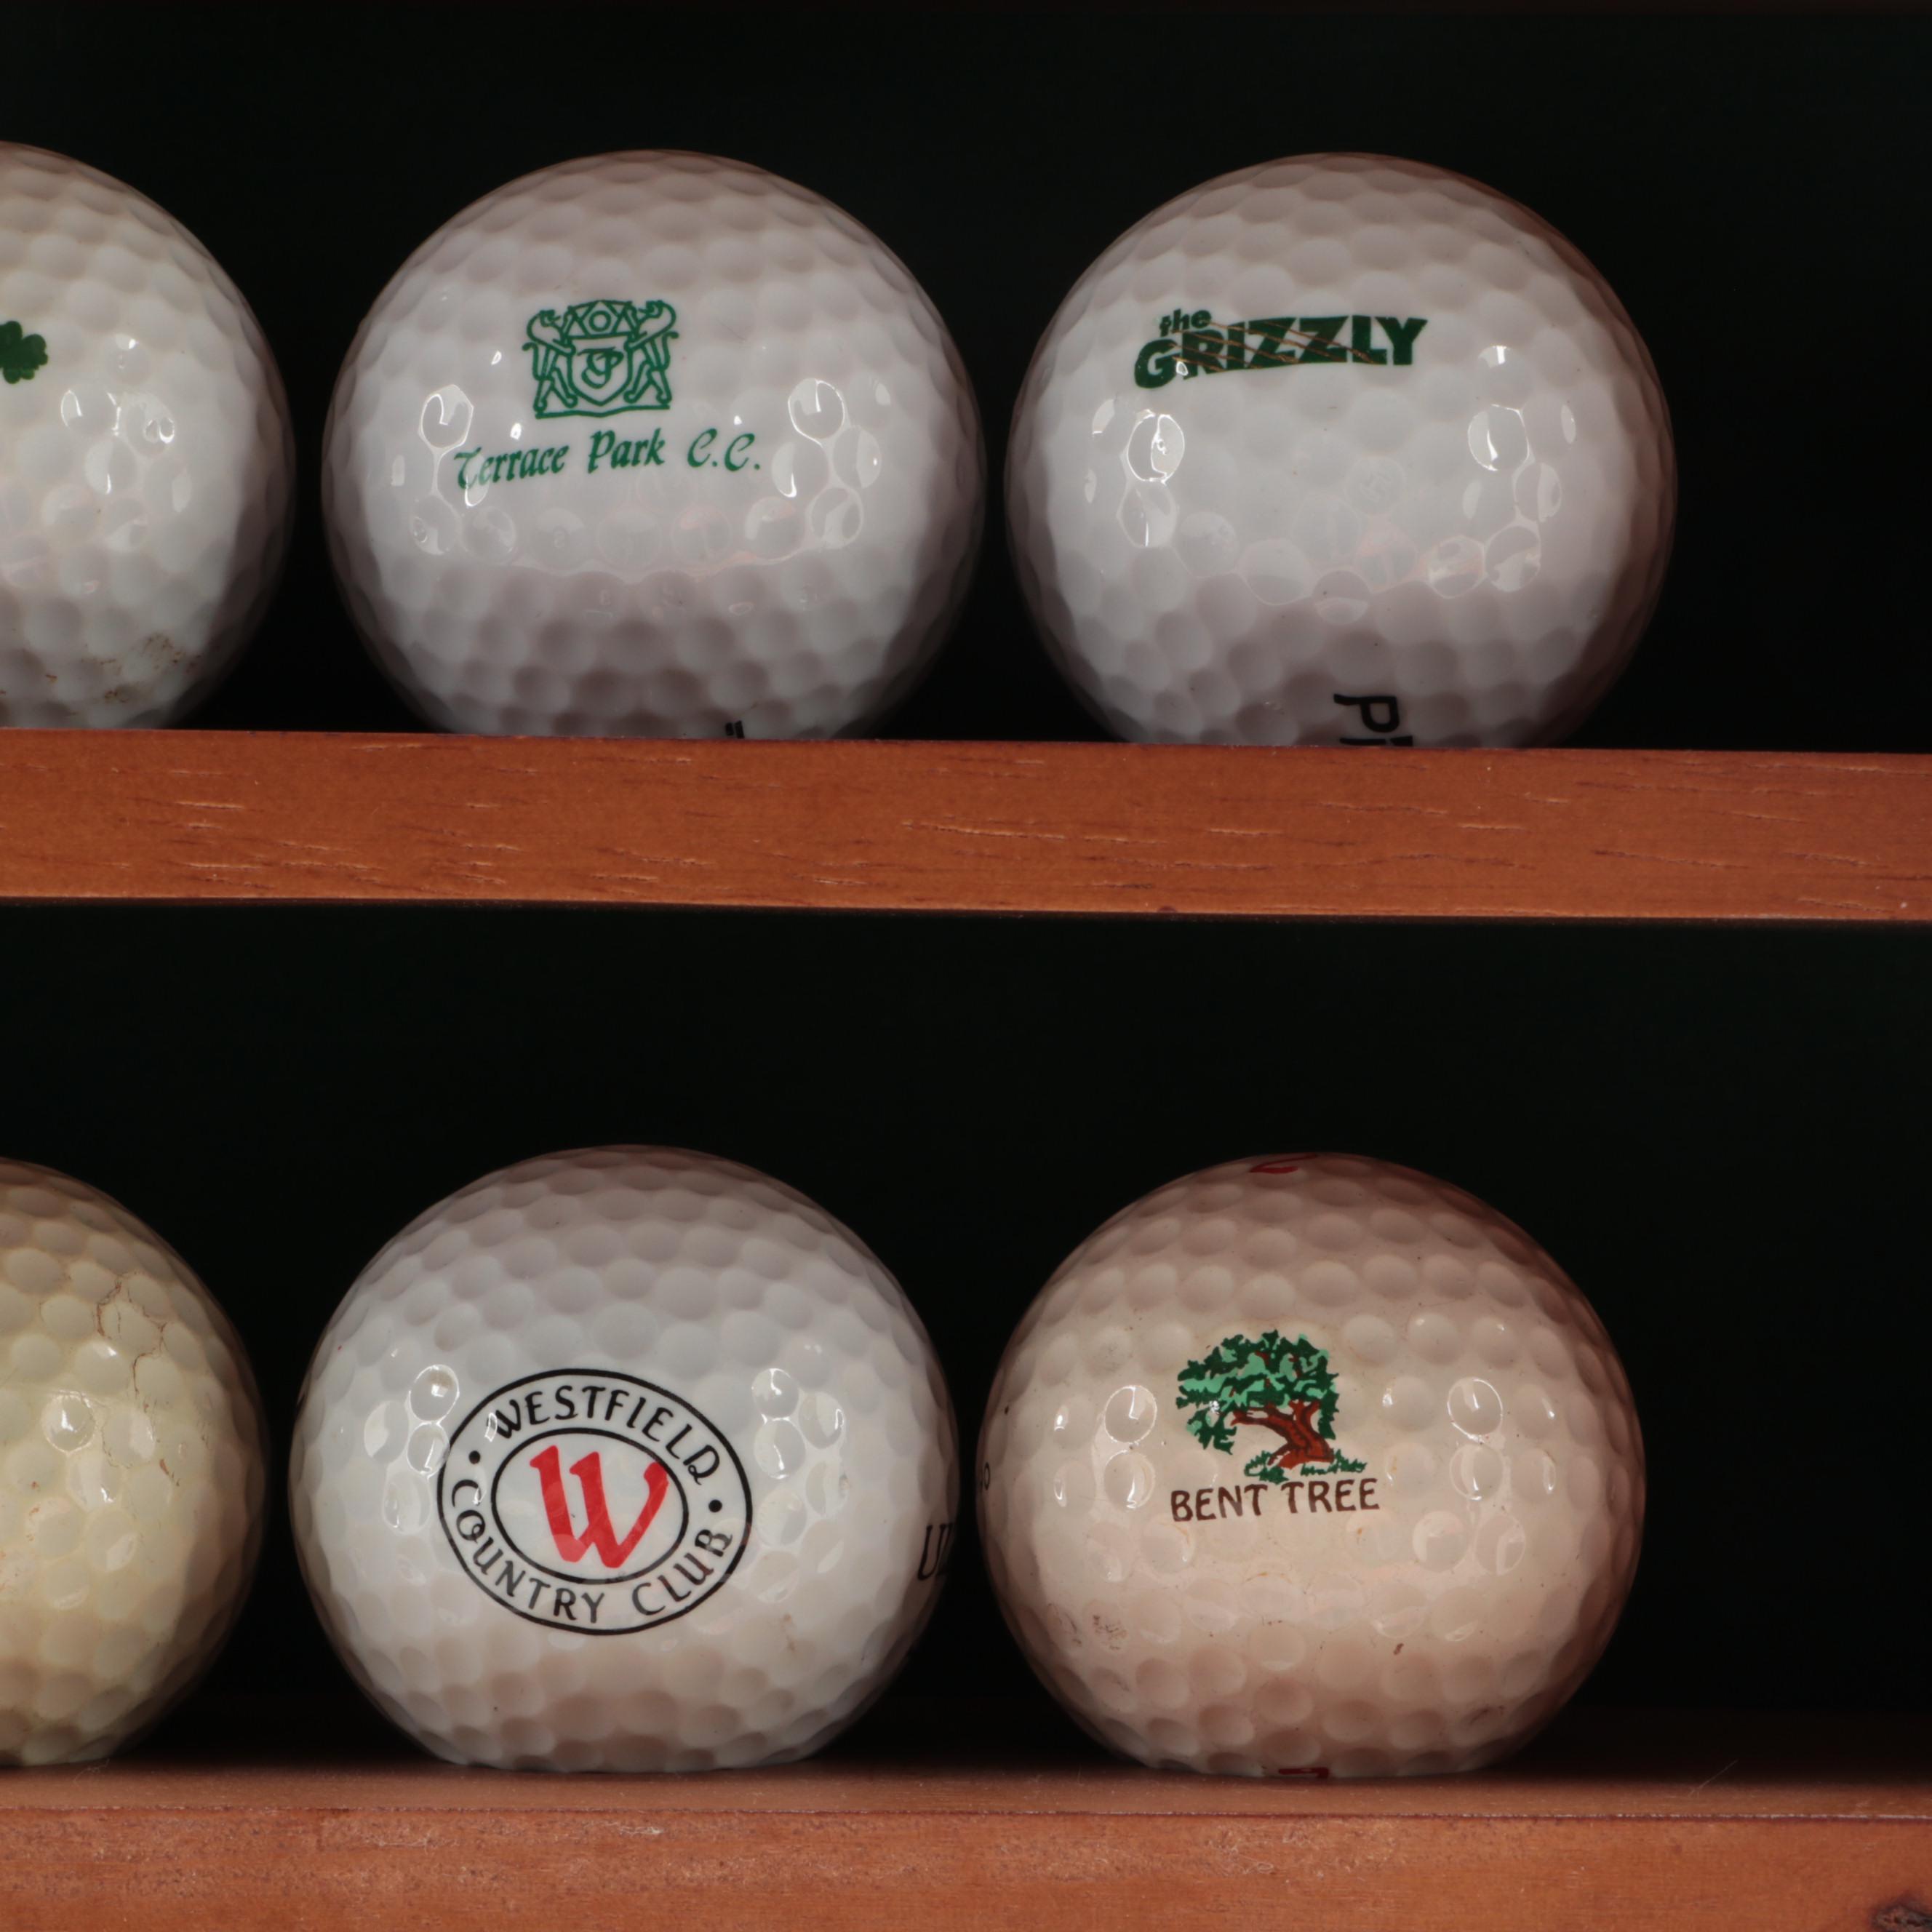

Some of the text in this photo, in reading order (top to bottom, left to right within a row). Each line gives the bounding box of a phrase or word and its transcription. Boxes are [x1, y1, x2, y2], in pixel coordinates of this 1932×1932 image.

[1134, 315, 1429, 388] GRIZZLY
[1158, 309, 1212, 337] the
[453, 428, 761, 489] Terrace Park C.C.
[486, 1385, 720, 1485] WESTFIELD
[530, 1445, 669, 1568] W
[1170, 1478, 1380, 1522] BENT TREE
[451, 1479, 733, 1624] COUNTRY CLUB
